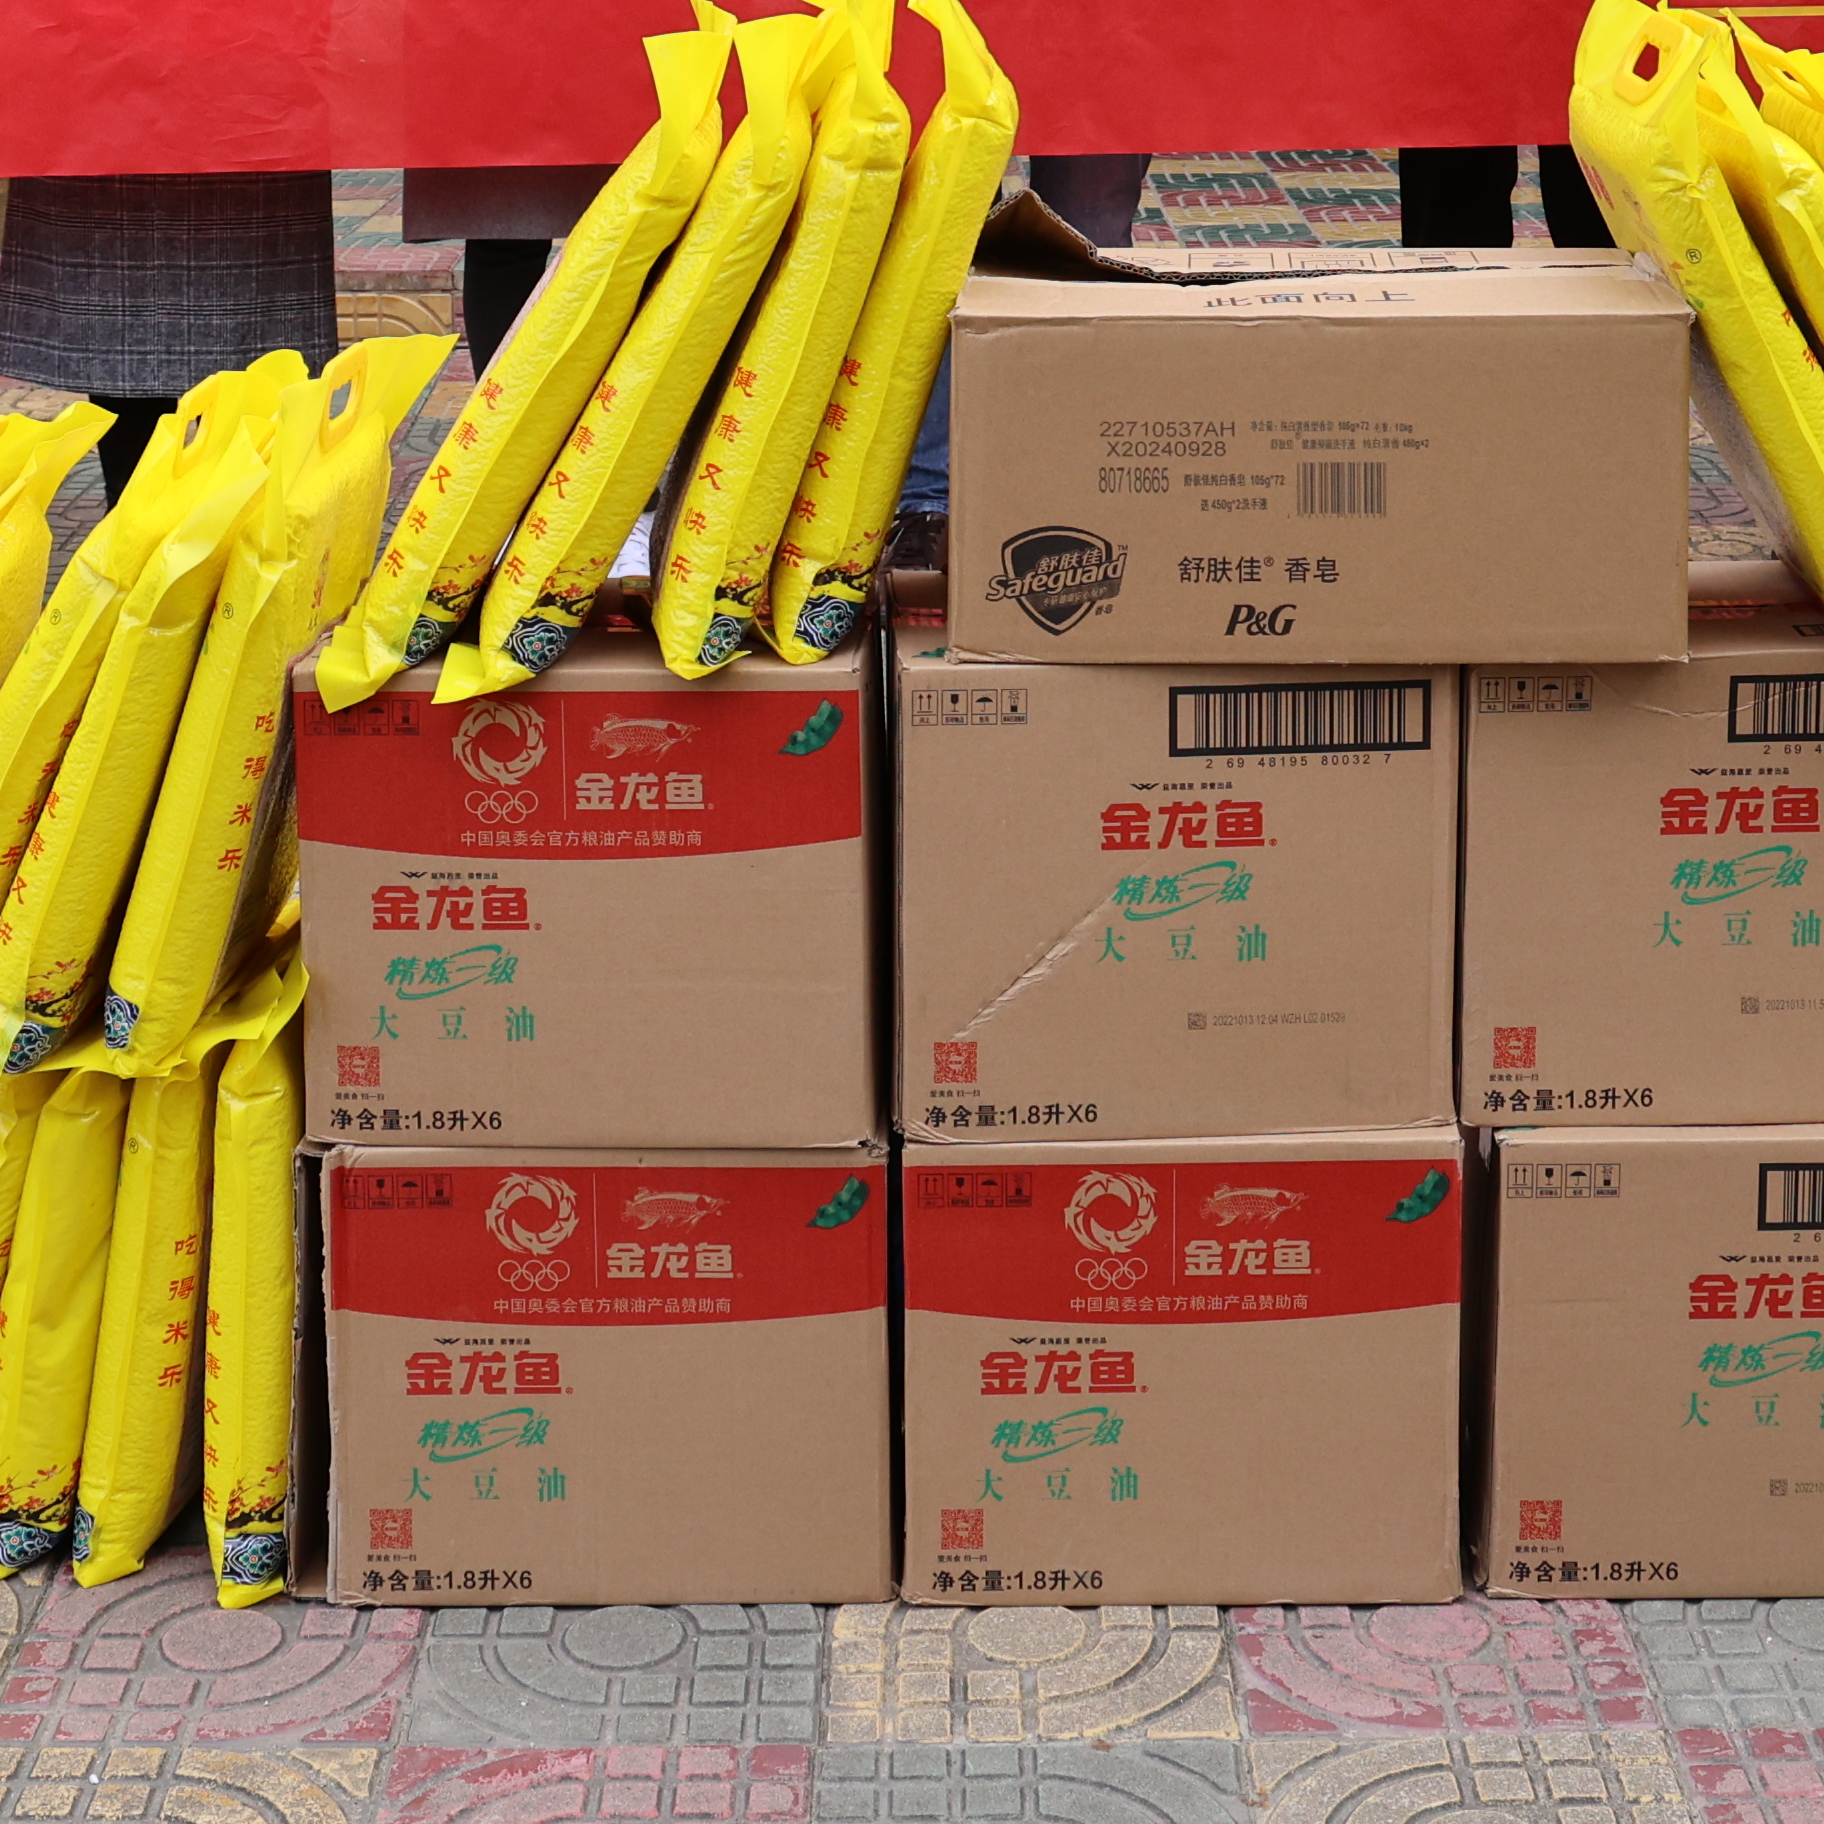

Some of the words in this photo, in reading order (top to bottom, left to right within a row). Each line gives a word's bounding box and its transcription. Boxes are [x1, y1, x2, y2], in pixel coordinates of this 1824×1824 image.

[1203, 290, 1416, 309] 此面向上
[1100, 422, 1236, 437] 22710537AH
[1106, 441, 1226, 457] X20240928
[383, 376, 505, 580] 健康又快乐
[669, 366, 758, 585] 健康又快乐
[779, 356, 861, 571] 健康又快乐
[1099, 467, 1169, 494] 80718665
[501, 380, 619, 588] 健康又快乐
[986, 552, 1127, 601] Safeguard
[1036, 548, 1102, 575] 舒肤佳
[1284, 557, 1340, 583] 香皂
[1224, 604, 1297, 635] P&G
[1206, 759, 1213, 770] 2
[1227, 757, 1245, 768] 69
[1258, 756, 1308, 768] 48195
[1321, 754, 1371, 765] 80032
[1384, 753, 1391, 764] 7
[217, 711, 275, 872] 吃得米乐
[574, 772, 705, 810] 金龙鱼
[1660, 786, 1821, 835] 金龙鱼
[460, 829, 703, 848] 中国奥委会官方粮油产品赞助商
[1101, 800, 1265, 851] 金龙鱼
[1111, 863, 1253, 918] 精炼一级
[1670, 847, 1808, 903] 精炼一级
[371, 884, 530, 932] 金龙鱼
[1095, 925, 1267, 963] 大豆油
[1653, 909, 1822, 949] 大豆油
[384, 947, 520, 997] 精炼一级
[371, 1006, 535, 1042] 大豆油
[606, 1242, 734, 1279] 金龙鱼
[1184, 1239, 1312, 1276] 金龙鱼
[157, 1233, 198, 1388] 吃得米乐
[493, 1298, 731, 1315] 中国奥委会官方粮油产品赞助商
[1070, 1294, 1308, 1312] 中国奥委会官方粮油产品赞助商
[405, 1351, 563, 1396] 金龙鱼
[980, 1349, 1137, 1395] 金龙鱼
[418, 1410, 550, 1461] 精炼一级
[991, 1409, 1124, 1462] 精炼一级
[403, 1466, 567, 1503] 大豆油
[976, 1467, 1139, 1502] 大豆油
